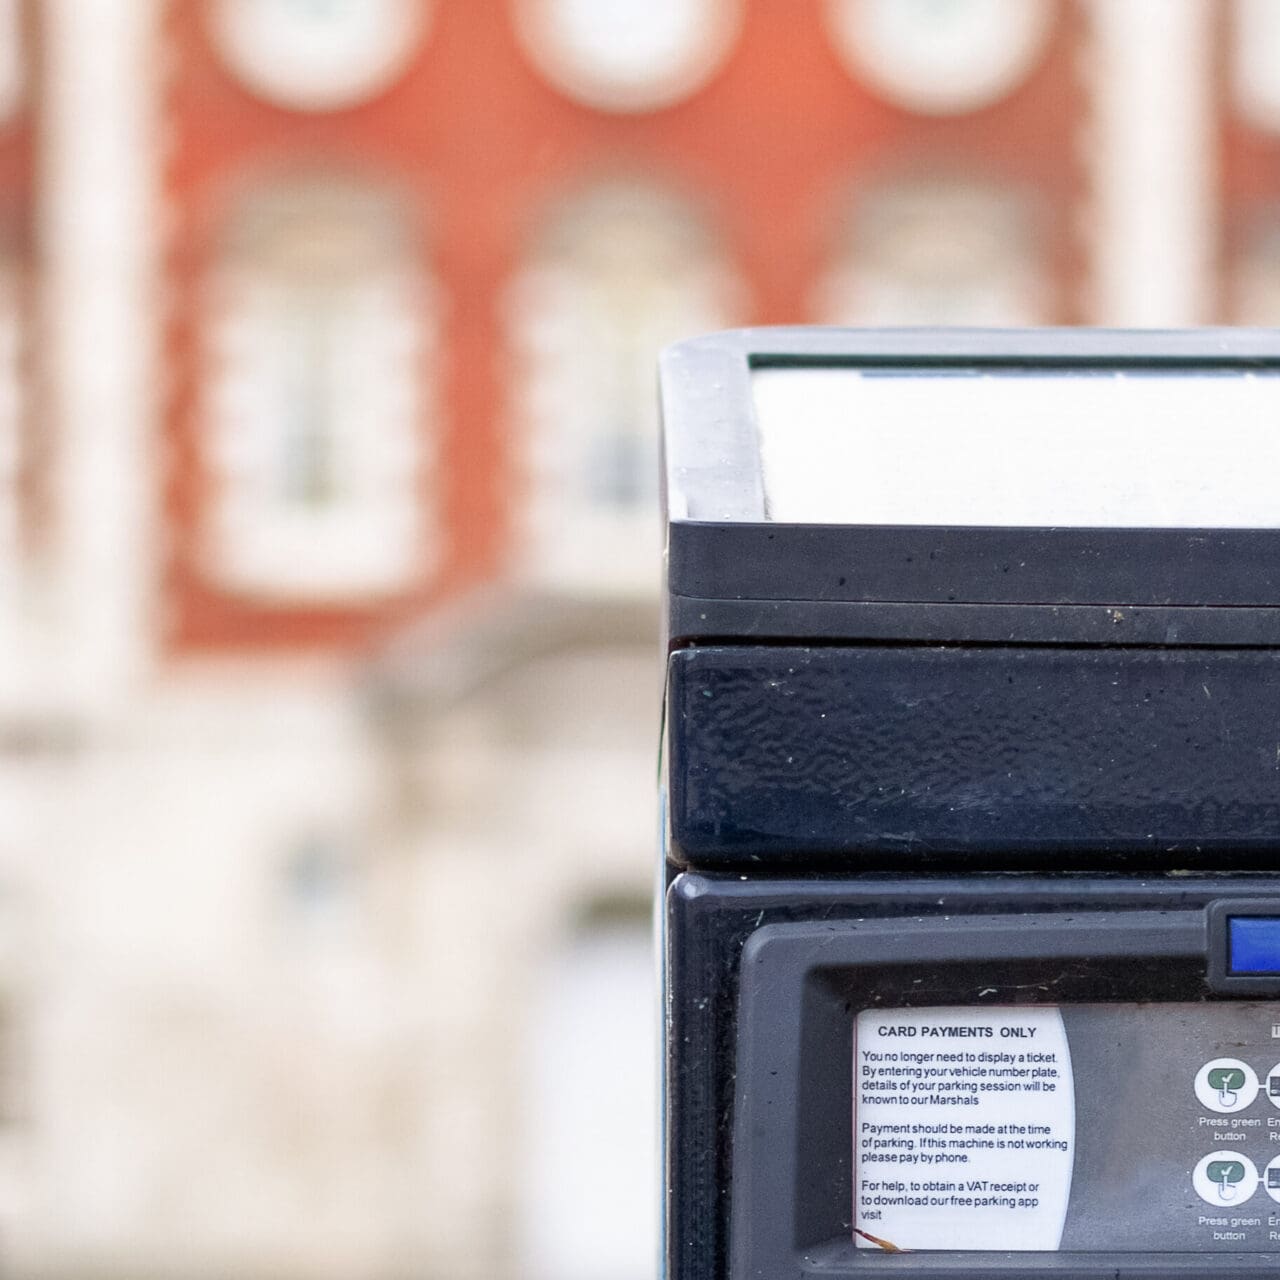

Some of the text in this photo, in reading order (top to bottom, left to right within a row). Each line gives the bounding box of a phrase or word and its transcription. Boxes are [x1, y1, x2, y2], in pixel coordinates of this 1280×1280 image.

[878, 1026, 1036, 1037] CARD PAYMENTS ONLY
[862, 1051, 883, 1061] You
[900, 1052, 934, 1064] longer
[937, 1053, 963, 1062] need
[966, 1053, 976, 1062] to
[978, 1052, 1016, 1065] display
[862, 1067, 876, 1078] By
[878, 1066, 922, 1078] entering
[924, 1068, 948, 1079] your
[949, 1066, 987, 1077] vehicle
[989, 1067, 1030, 1077] number
[862, 1094, 897, 1104] known
[899, 1095, 909, 1104] to
[930, 1095, 979, 1105] Marshals
[1199, 1117, 1261, 1128] Press green
[1214, 1131, 1246, 1140] button
